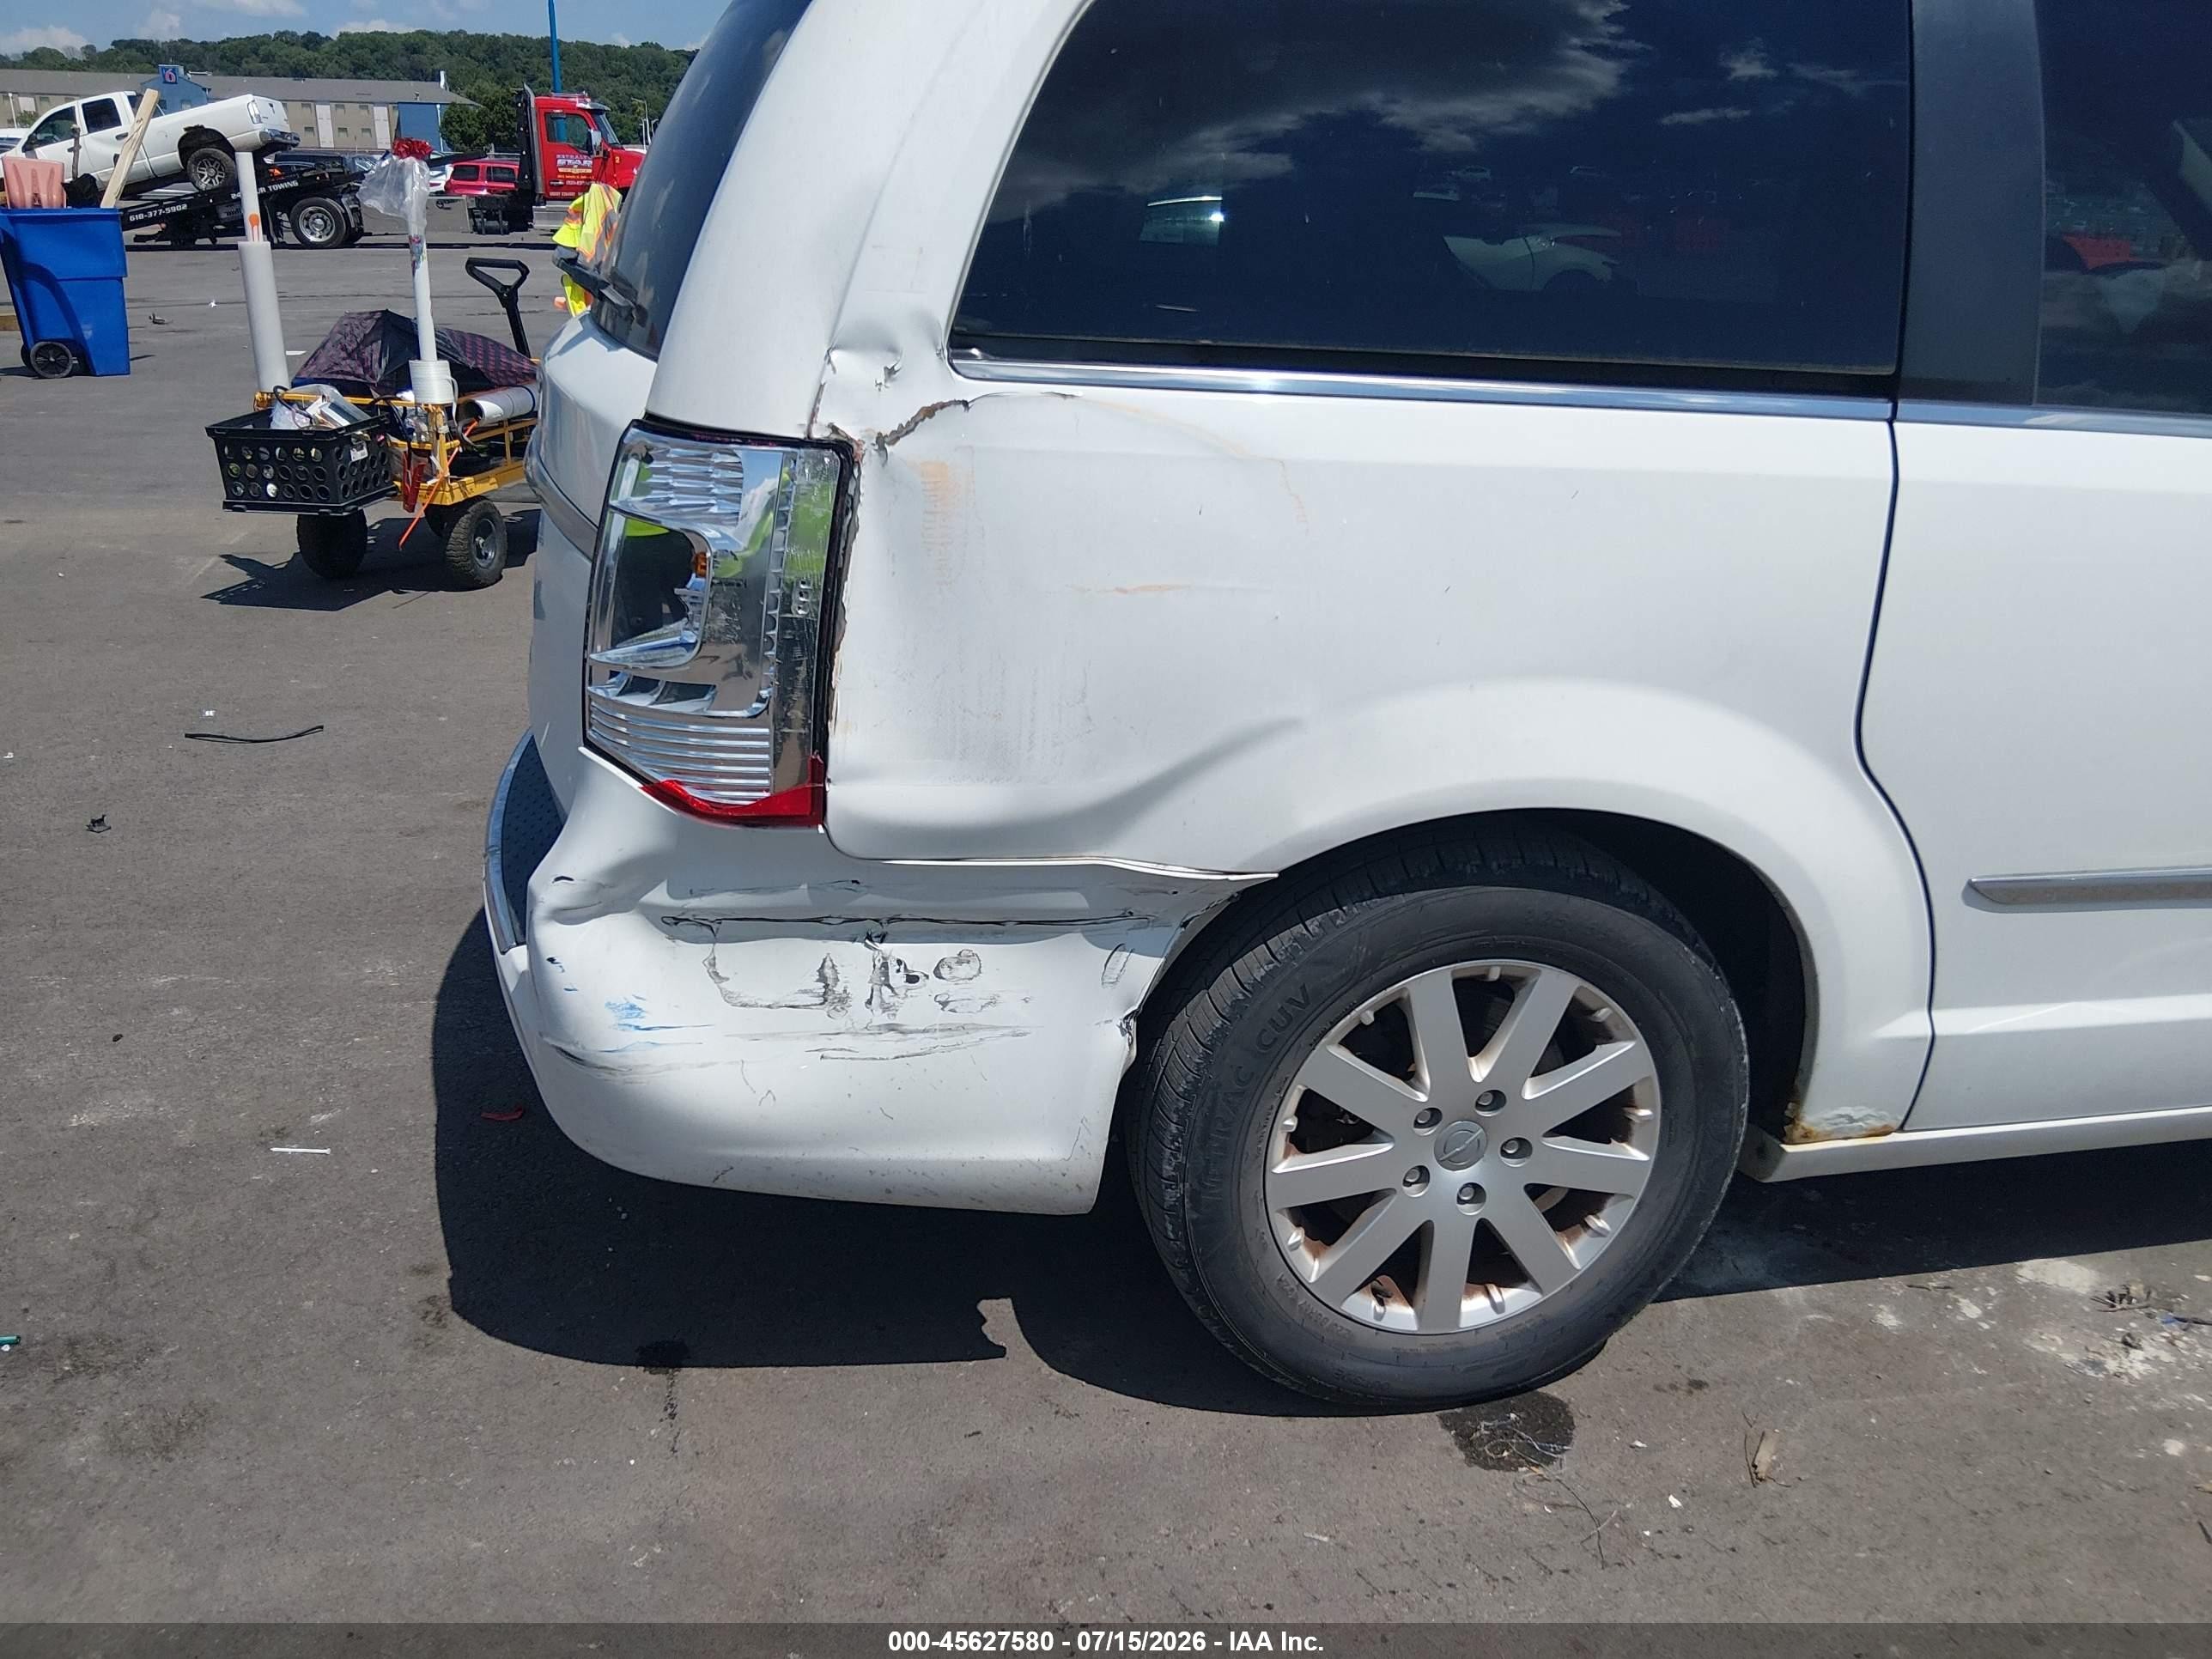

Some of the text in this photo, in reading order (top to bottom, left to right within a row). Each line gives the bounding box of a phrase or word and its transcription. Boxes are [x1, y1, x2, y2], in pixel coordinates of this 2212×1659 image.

[164, 68, 176, 83] 6
[267, 179, 299, 191] TOWING
[1255, 982, 1312, 1054] CUV
